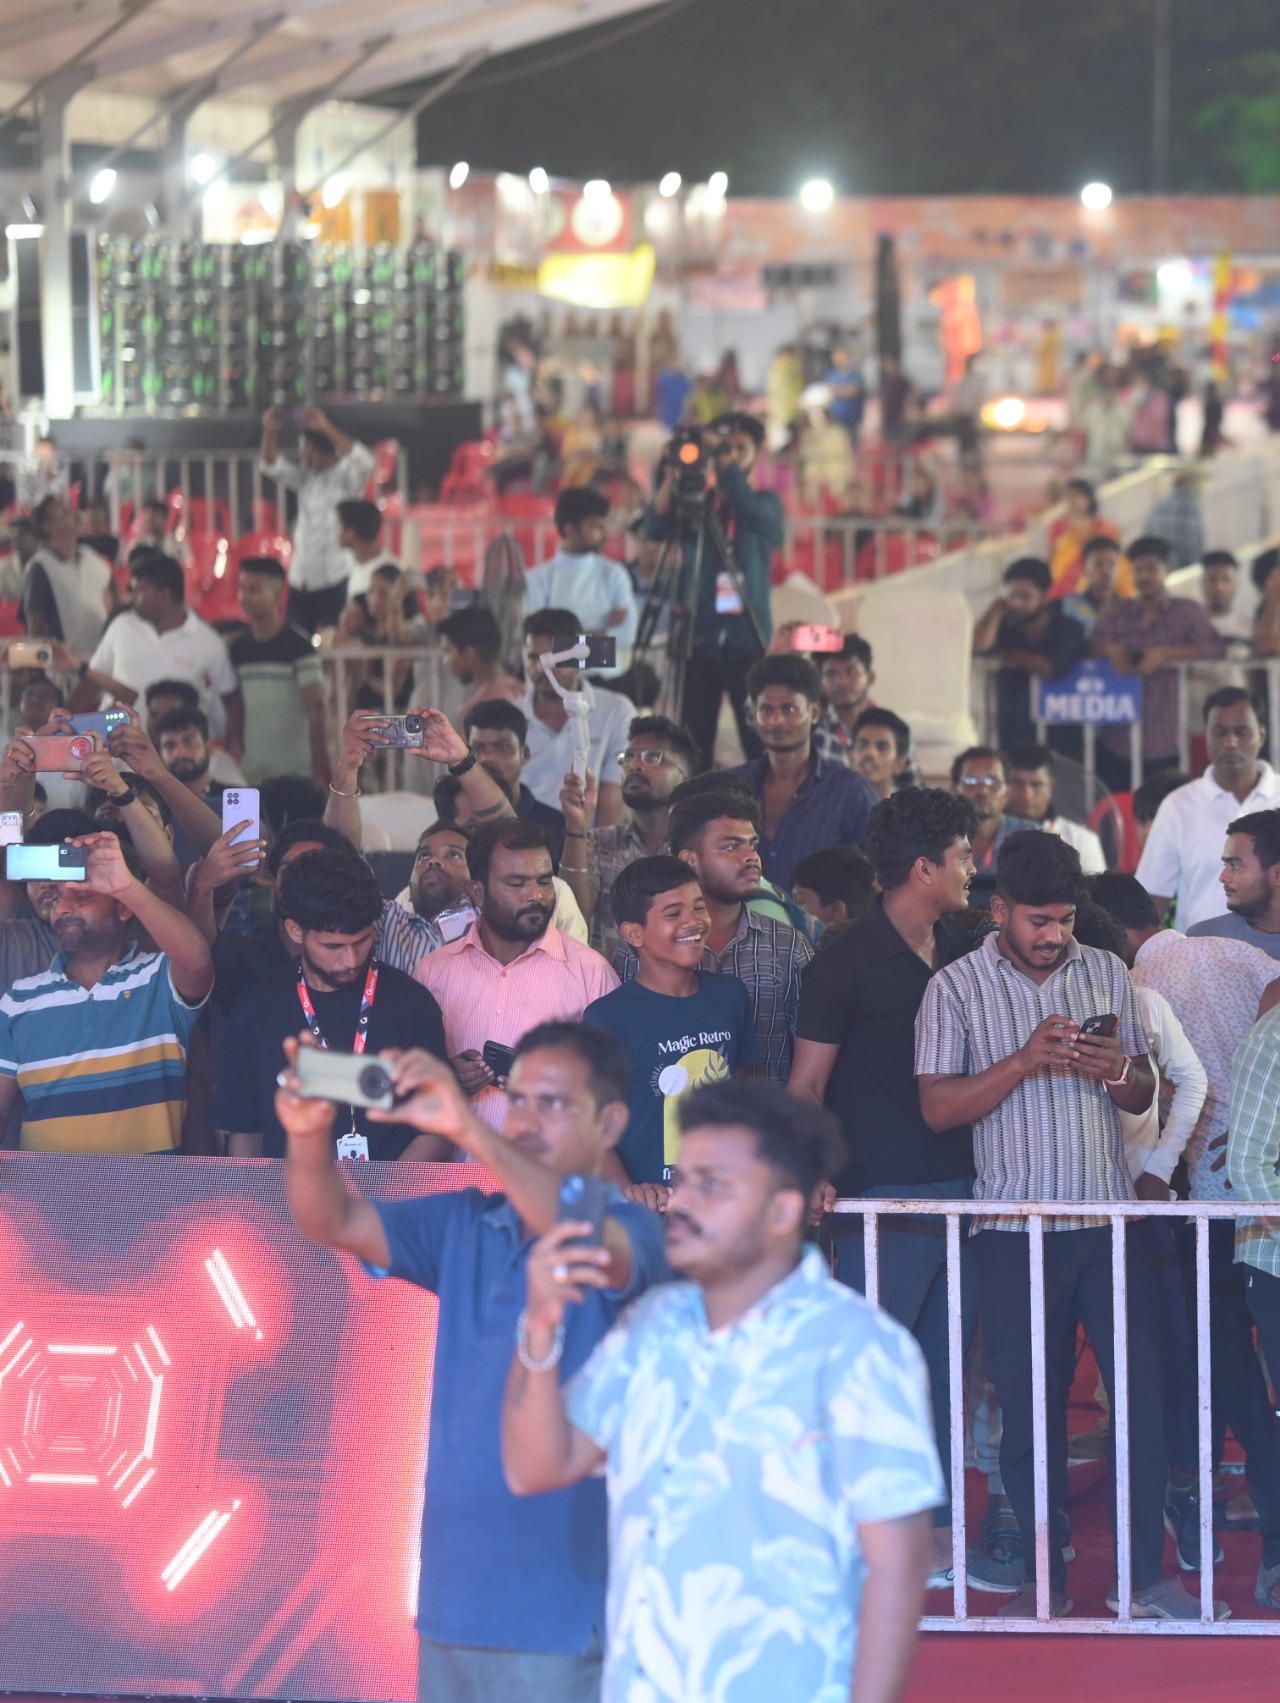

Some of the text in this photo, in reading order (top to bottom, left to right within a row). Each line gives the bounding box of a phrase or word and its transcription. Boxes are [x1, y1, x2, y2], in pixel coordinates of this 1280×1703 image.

[1045, 693, 1135, 721] MEDIA
[658, 1031, 731, 1054] Magic Retro
[649, 1062, 664, 1097] artistic
